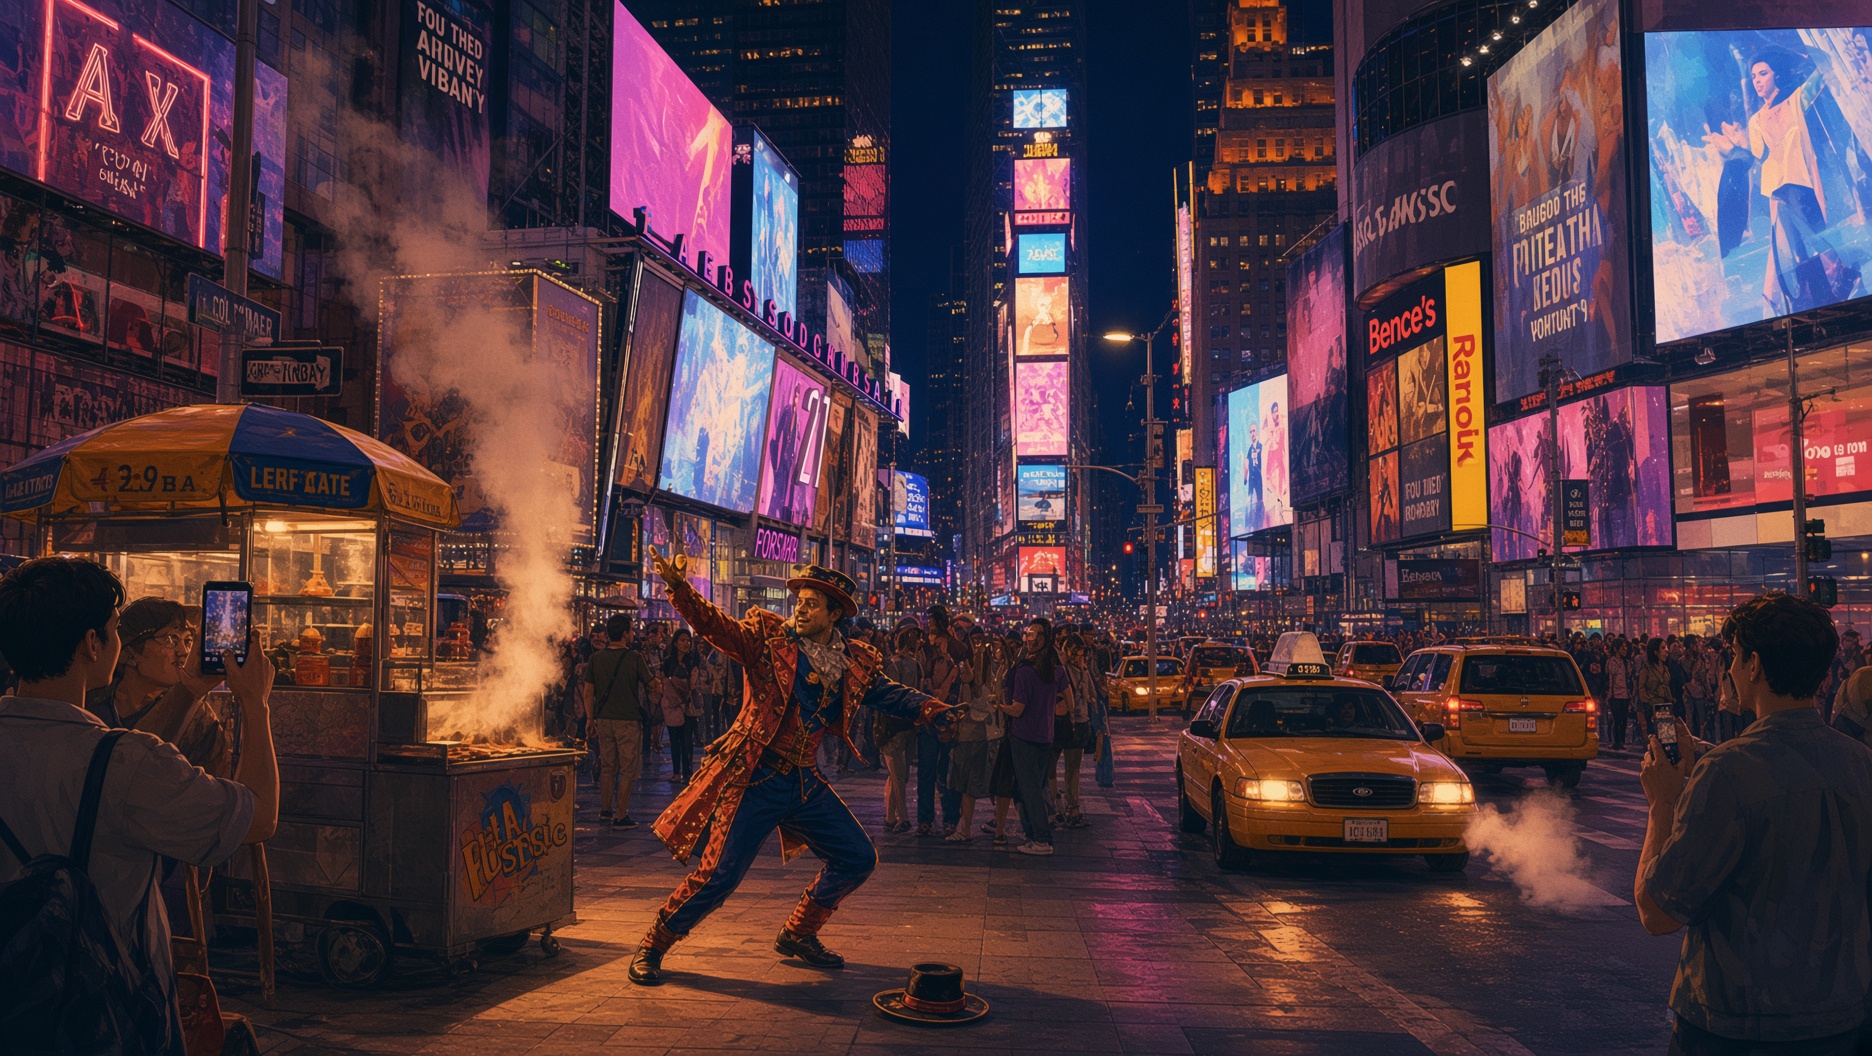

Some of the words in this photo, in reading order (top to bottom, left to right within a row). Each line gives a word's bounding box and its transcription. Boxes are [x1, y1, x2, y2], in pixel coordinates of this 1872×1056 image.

[417, 1, 445, 36] FOU
[450, 22, 483, 60] THED
[1369, 295, 1437, 355] Bence's
